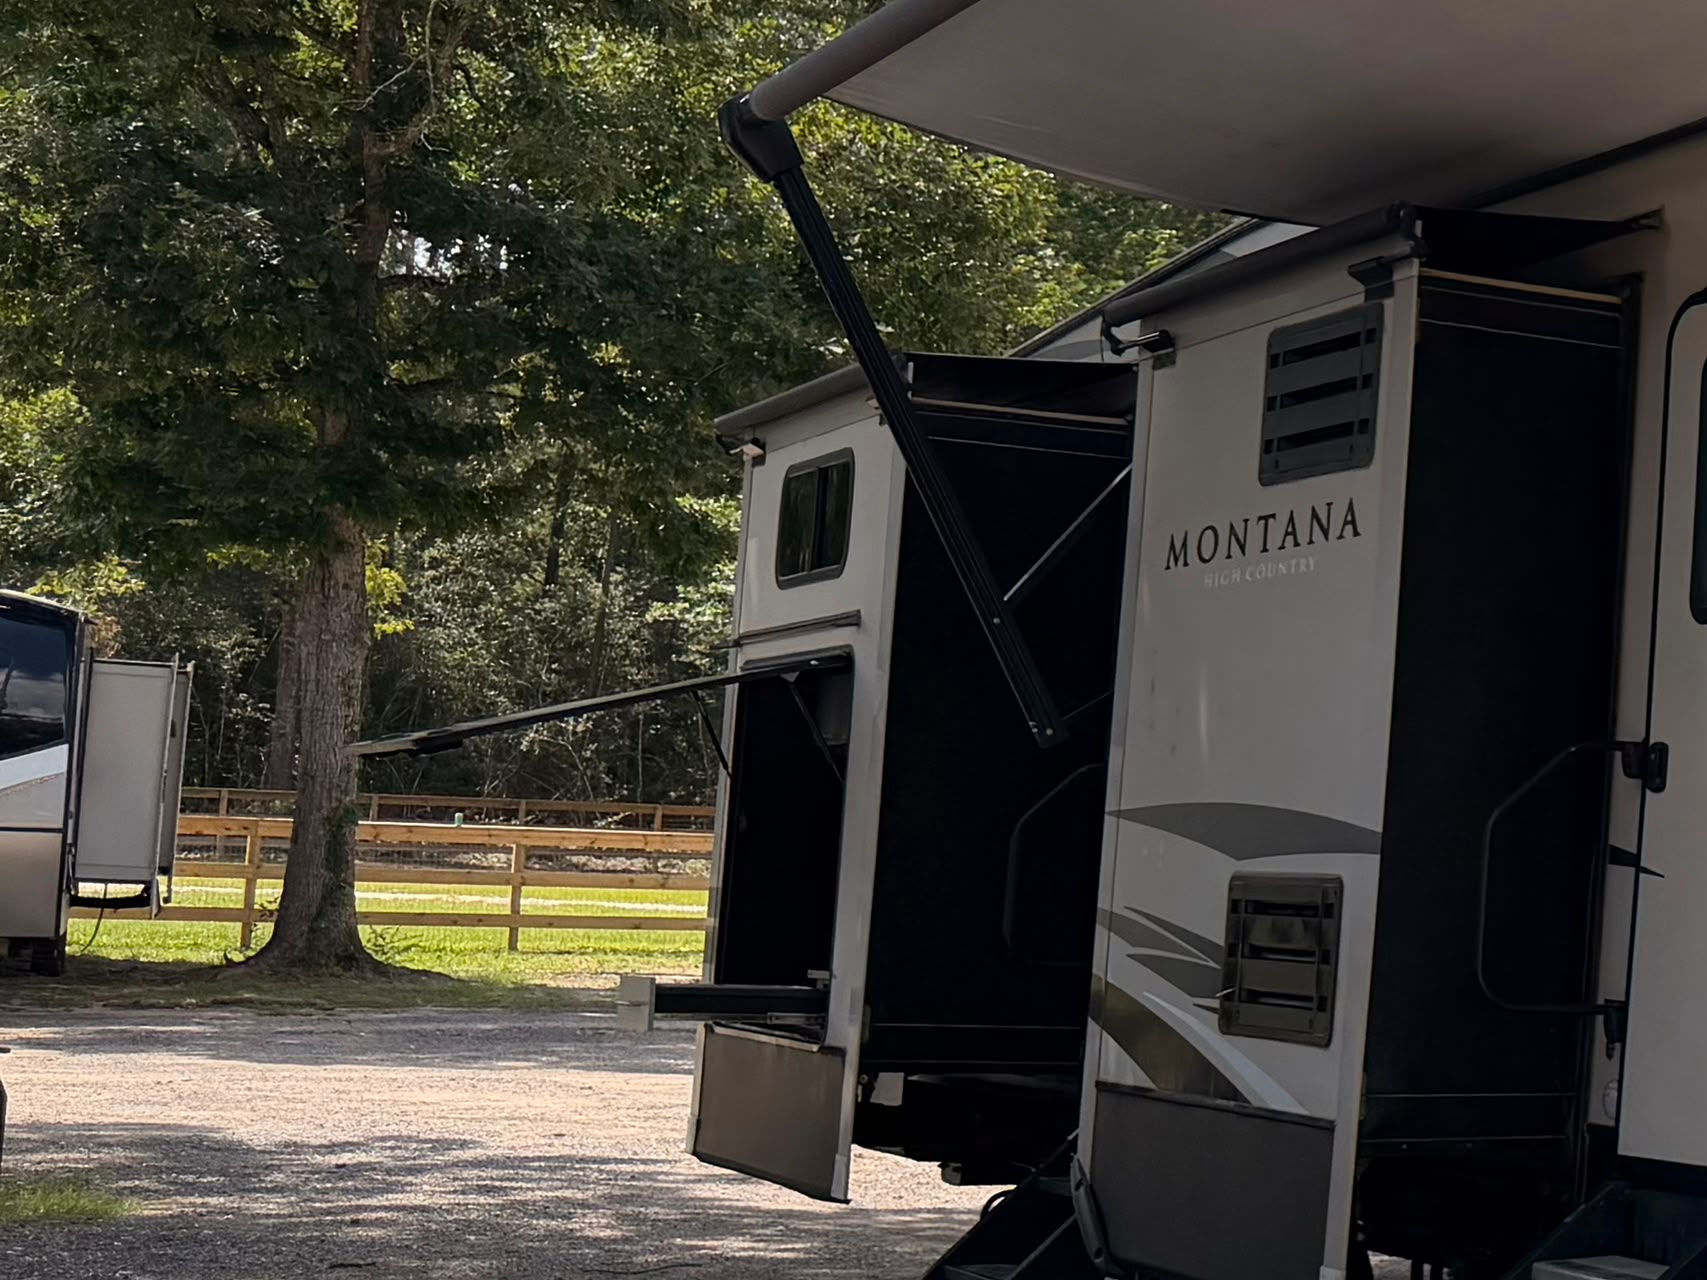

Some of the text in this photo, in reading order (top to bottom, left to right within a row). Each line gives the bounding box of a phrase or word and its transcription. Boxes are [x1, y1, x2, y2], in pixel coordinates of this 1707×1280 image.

[1164, 496, 1362, 571] MONTANA
[1203, 555, 1317, 588] HIGH COUNTRY
